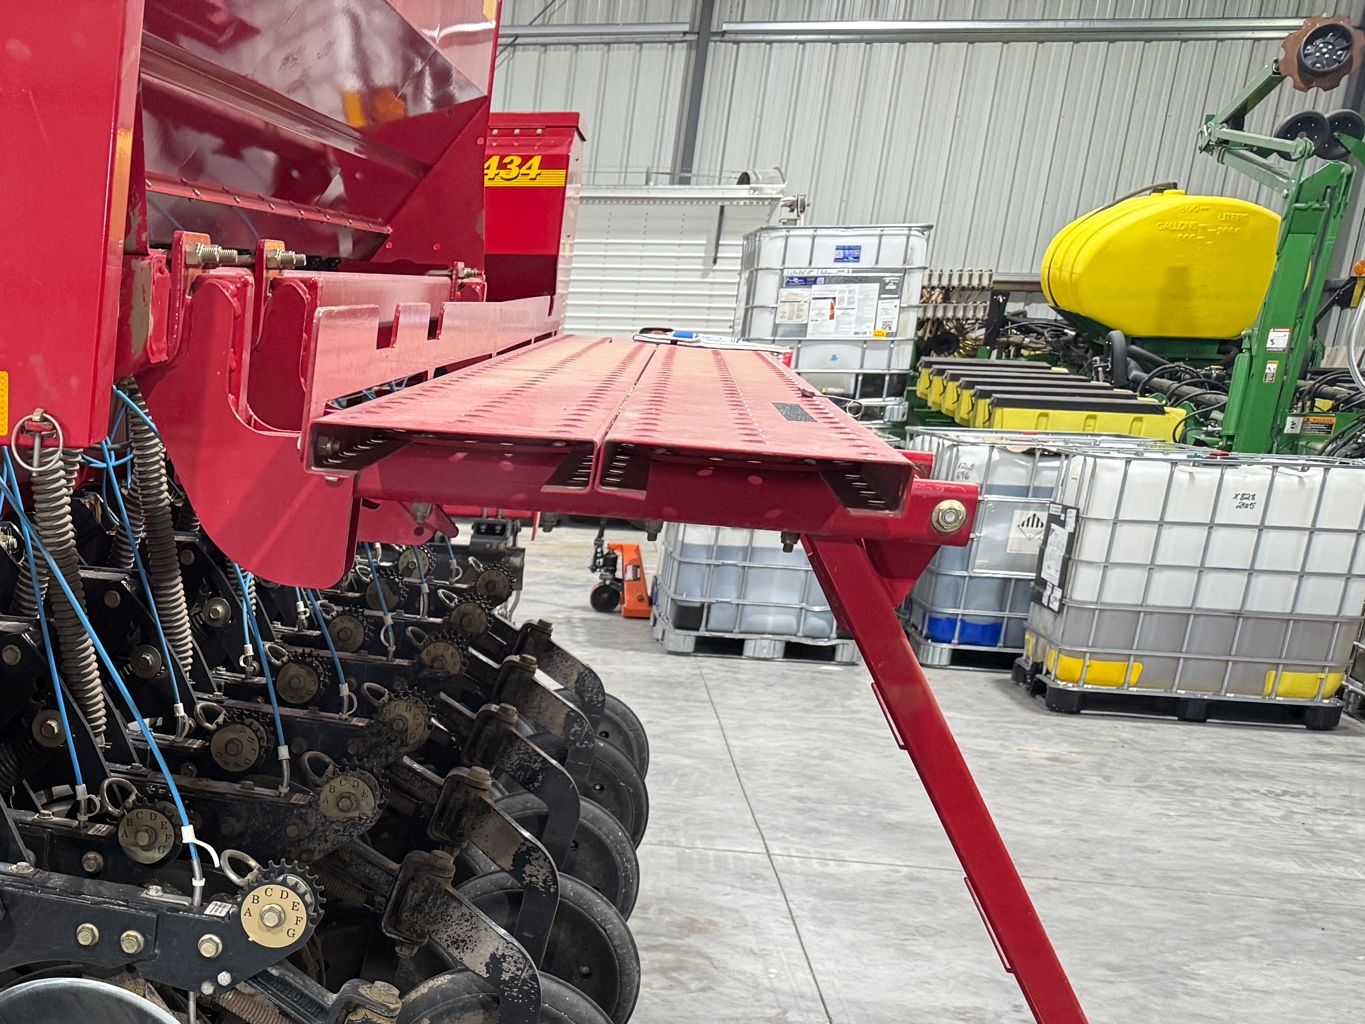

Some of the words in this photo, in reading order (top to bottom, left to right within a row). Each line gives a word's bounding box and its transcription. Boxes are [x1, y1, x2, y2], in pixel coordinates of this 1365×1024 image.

[484, 155, 542, 181] 434
[1218, 212, 1249, 221] LITERS
[1157, 221, 1198, 231] GALLONS
[322, 796, 329, 804] A
[329, 785, 336, 793] B
[339, 778, 347, 787] C
[136, 811, 143, 820] C
[150, 812, 157, 821] D
[126, 818, 133, 827] B
[160, 821, 168, 830] E
[121, 830, 128, 838] A
[166, 833, 172, 842] F
[157, 845, 166, 854] G
[264, 887, 273, 897] C
[280, 889, 289, 900] D
[251, 894, 260, 904] B
[291, 901, 300, 912] E
[243, 907, 252, 917] A
[295, 916, 303, 926] F
[286, 927, 296, 938] G
